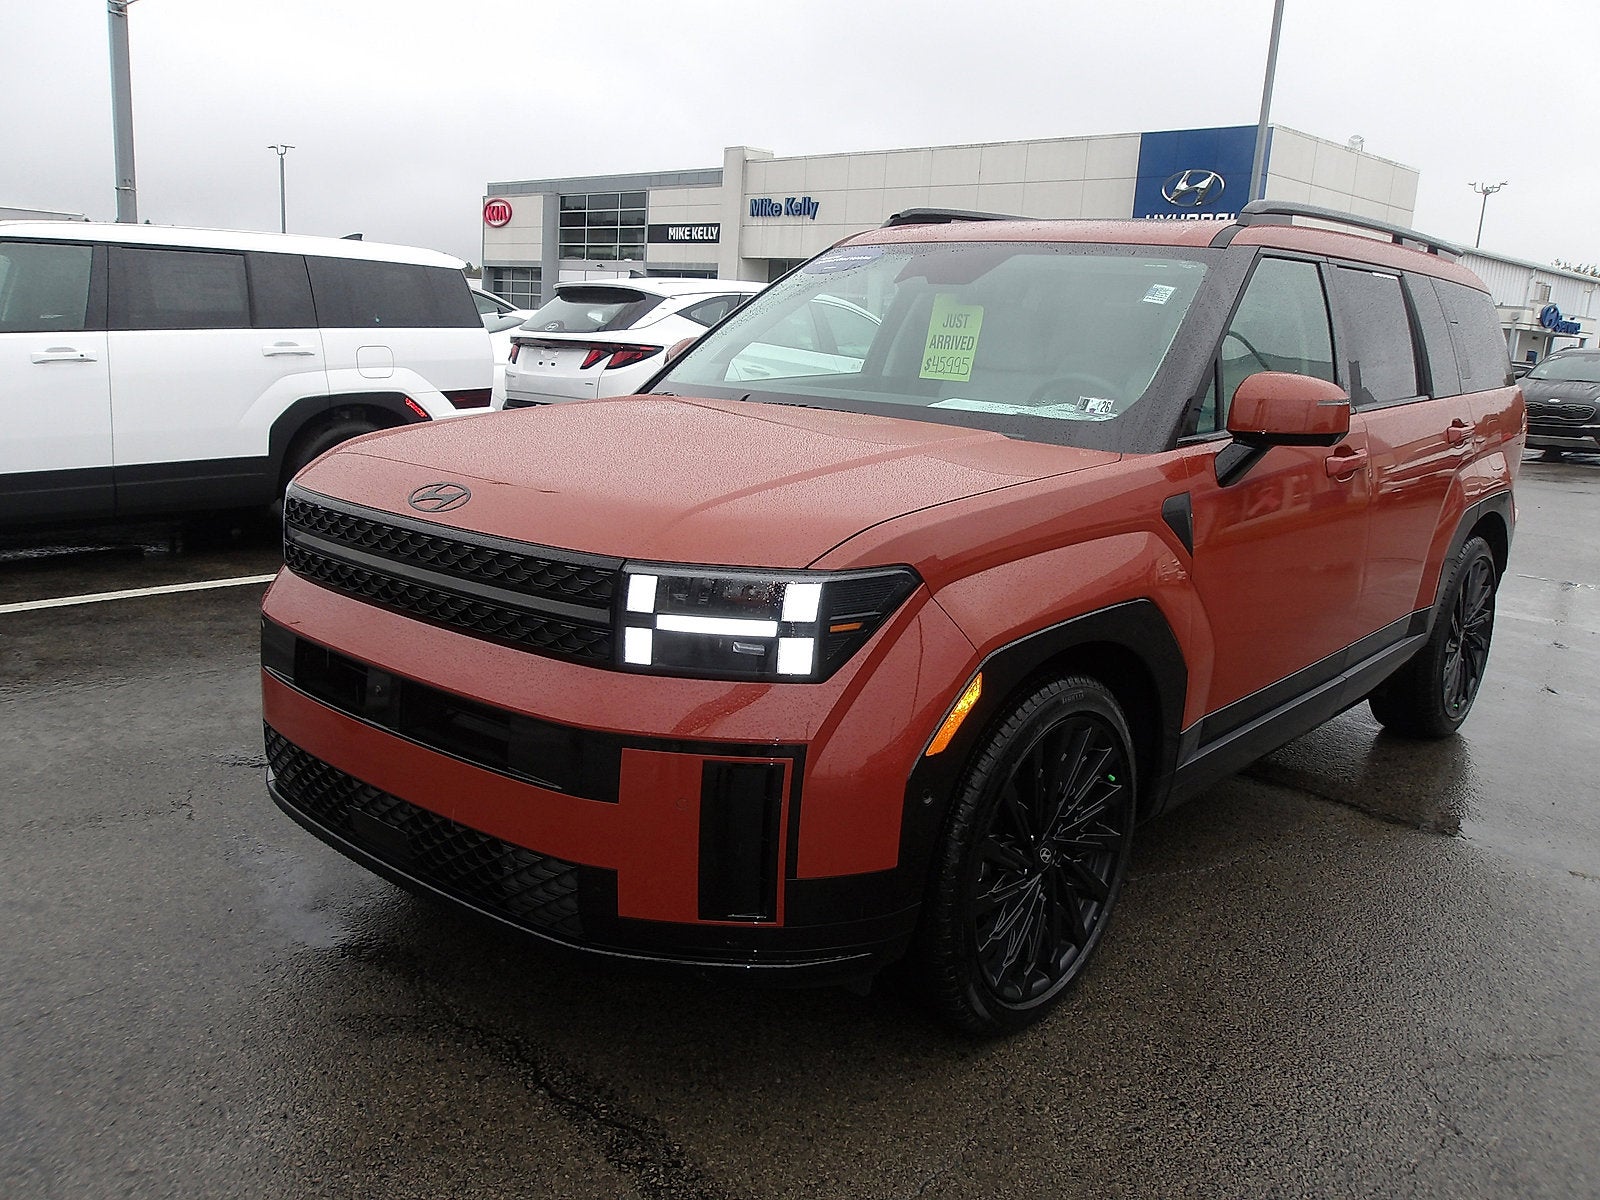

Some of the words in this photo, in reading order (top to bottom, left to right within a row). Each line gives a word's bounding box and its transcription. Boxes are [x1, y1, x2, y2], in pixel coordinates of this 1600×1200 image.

[485, 205, 507, 221] KIA
[749, 198, 782, 217] Mike
[784, 196, 820, 220] Kelly
[668, 226, 691, 240] MIKE
[691, 226, 719, 240] KELLY
[942, 313, 970, 329] JUST
[929, 334, 975, 351] ARRIVED
[1100, 400, 1112, 413] 26
